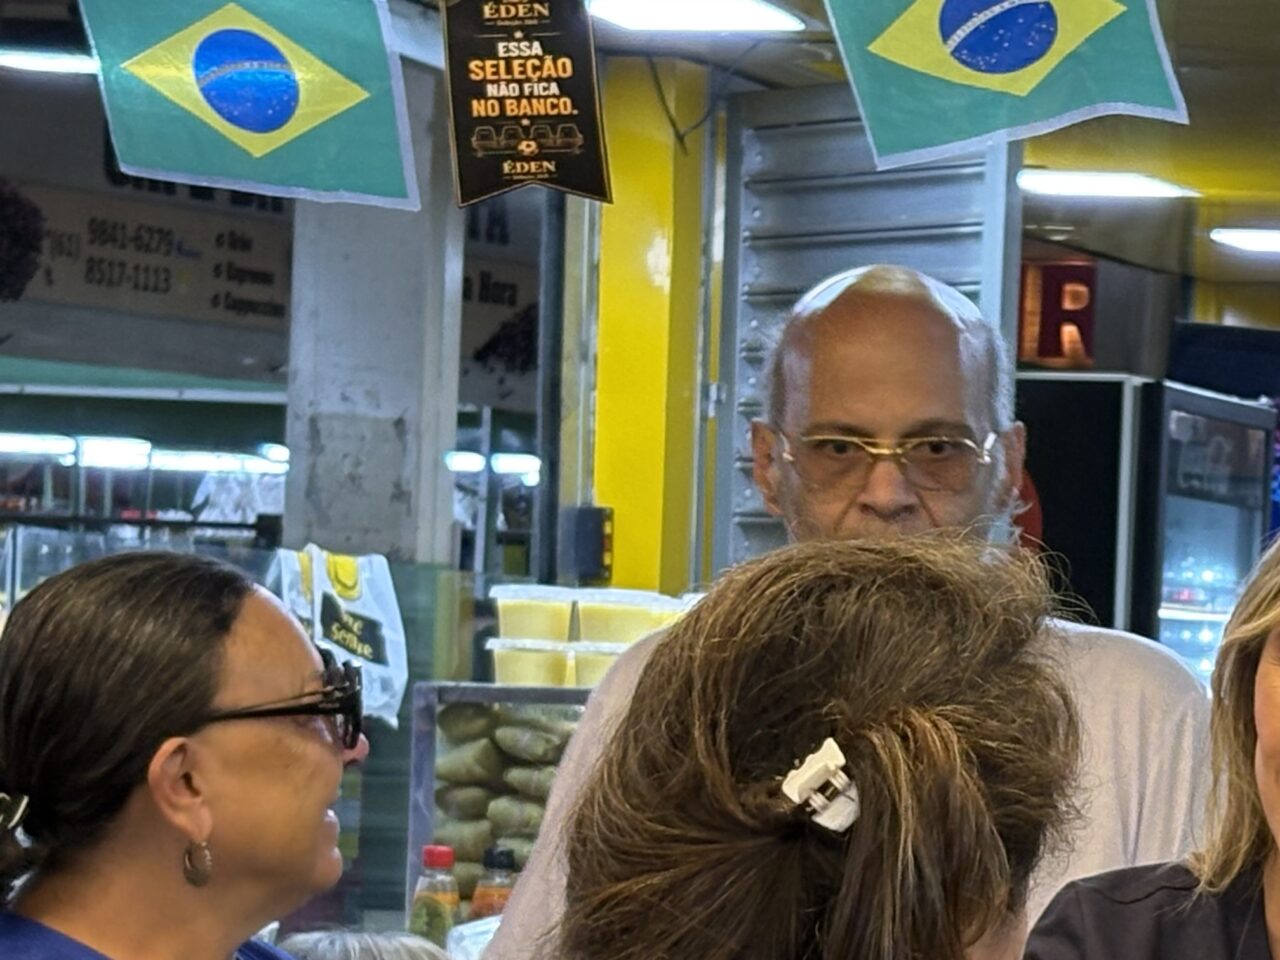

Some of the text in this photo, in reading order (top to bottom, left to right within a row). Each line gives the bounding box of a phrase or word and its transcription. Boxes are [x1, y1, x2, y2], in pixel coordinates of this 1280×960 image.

[482, 2, 550, 19] ÉDEN
[497, 41, 543, 58] ESSA
[468, 55, 573, 82] SELEÇÃO
[486, 81, 560, 98] NÃO FICA
[471, 96, 579, 118] NO BANCO.
[502, 160, 557, 175] ÉDEN
